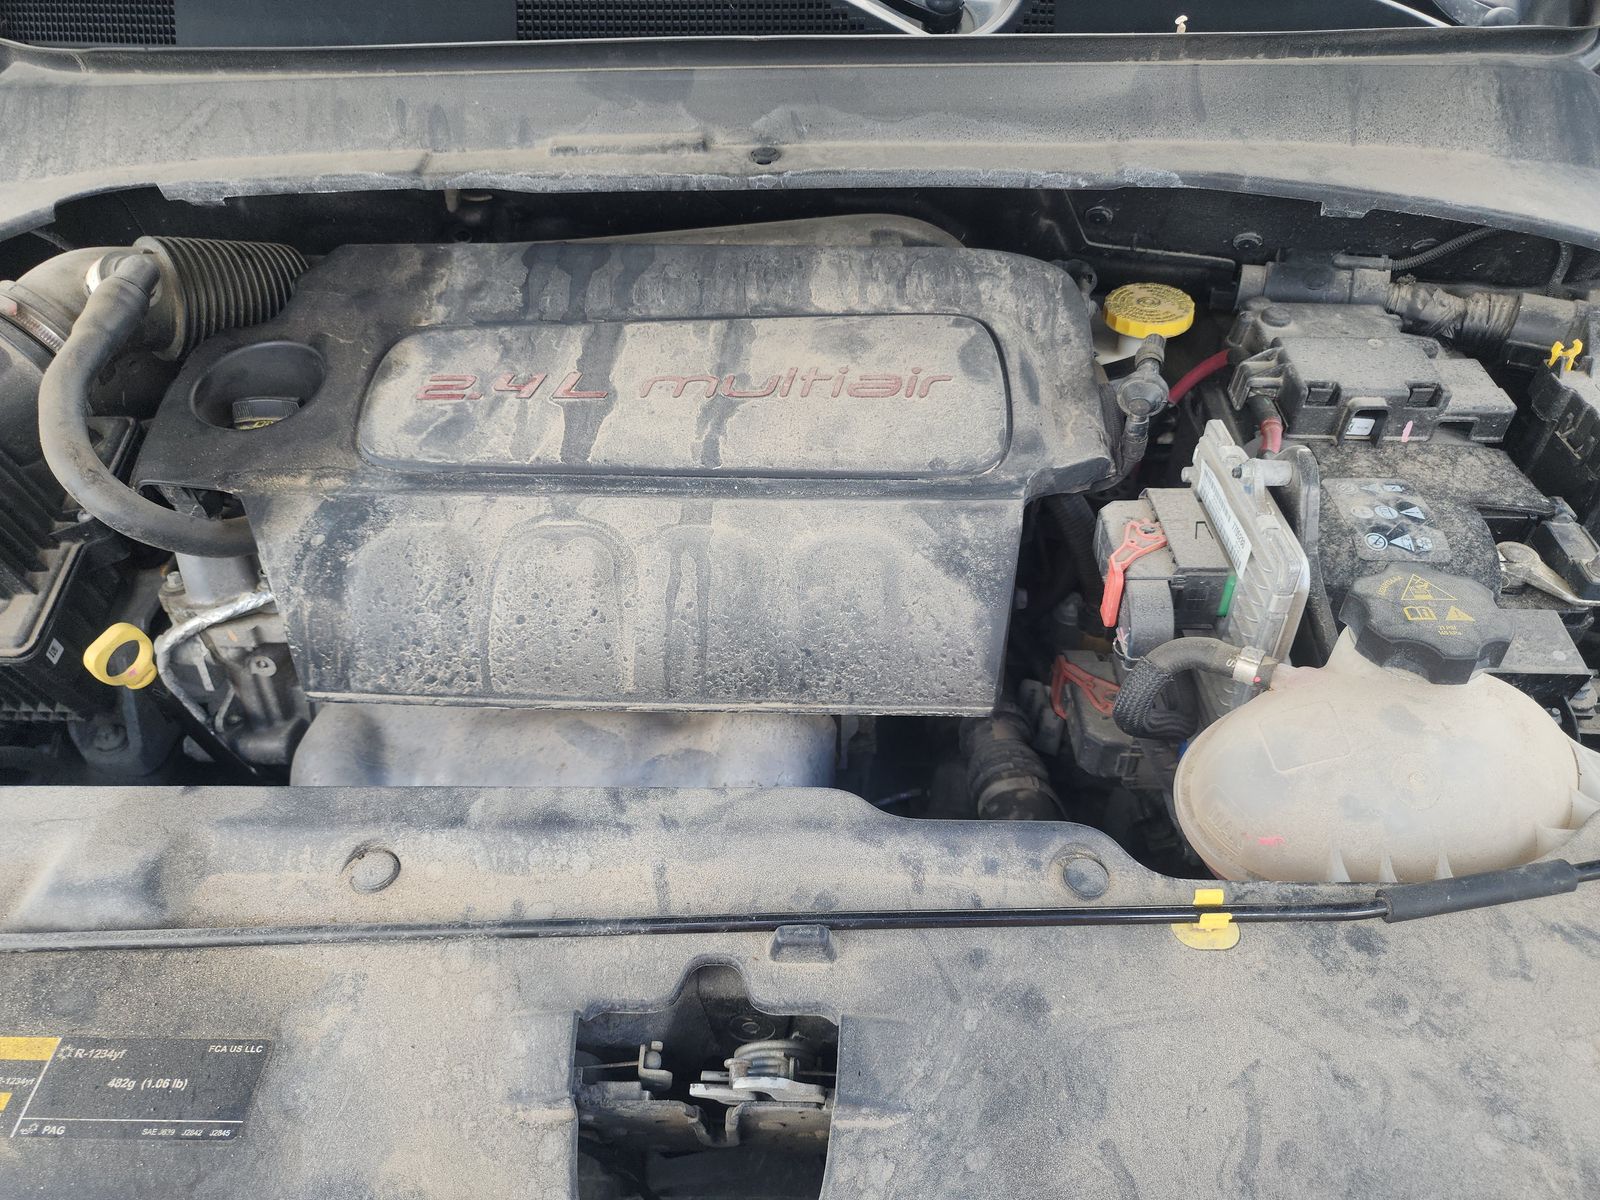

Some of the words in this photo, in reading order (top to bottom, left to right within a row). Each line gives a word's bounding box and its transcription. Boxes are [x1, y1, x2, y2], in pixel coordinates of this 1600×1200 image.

[416, 371, 609, 400] 2.4L
[639, 366, 954, 399] multiair
[74, 1048, 128, 1061] R-1234yf
[208, 1045, 228, 1053] FCA
[229, 1045, 243, 1053] US
[244, 1045, 264, 1053] LLC
[107, 1077, 137, 1091] 482g
[141, 1077, 171, 1090] (1.06
[172, 1078, 188, 1091] lb)
[41, 1125, 66, 1135] PAG
[141, 1128, 158, 1136] SAE
